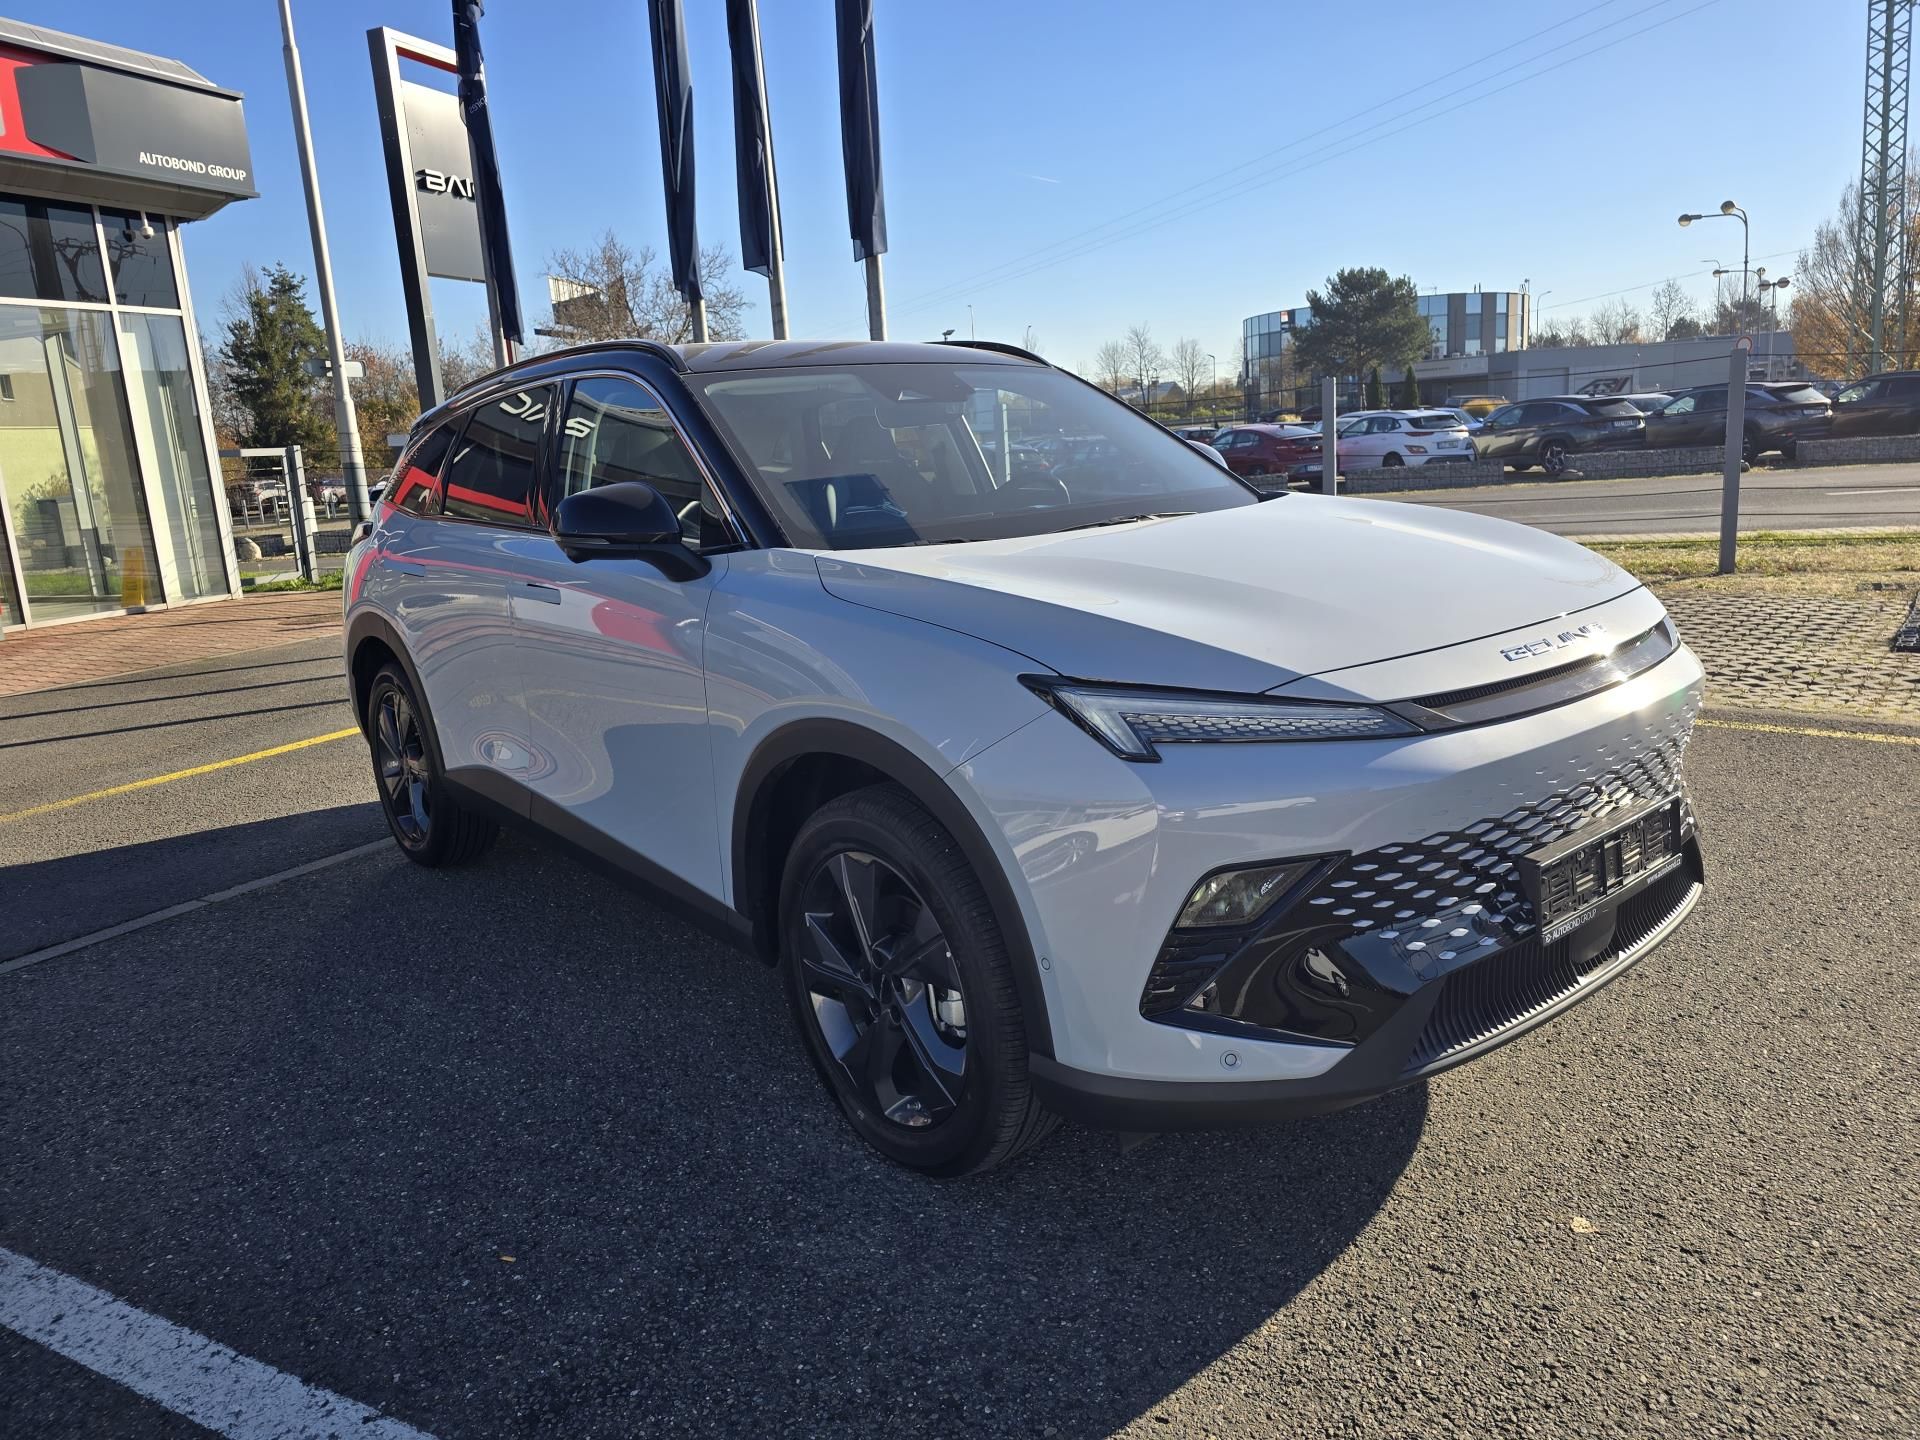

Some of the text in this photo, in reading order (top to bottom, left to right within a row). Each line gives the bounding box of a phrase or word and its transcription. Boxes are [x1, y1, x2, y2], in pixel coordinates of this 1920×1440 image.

[139, 151, 247, 182] AUTOBOND GROUP
[425, 168, 475, 198] BAI
[1499, 623, 1607, 662] BEIJIN
[1552, 908, 1597, 940] AUTOBOND GROUP
